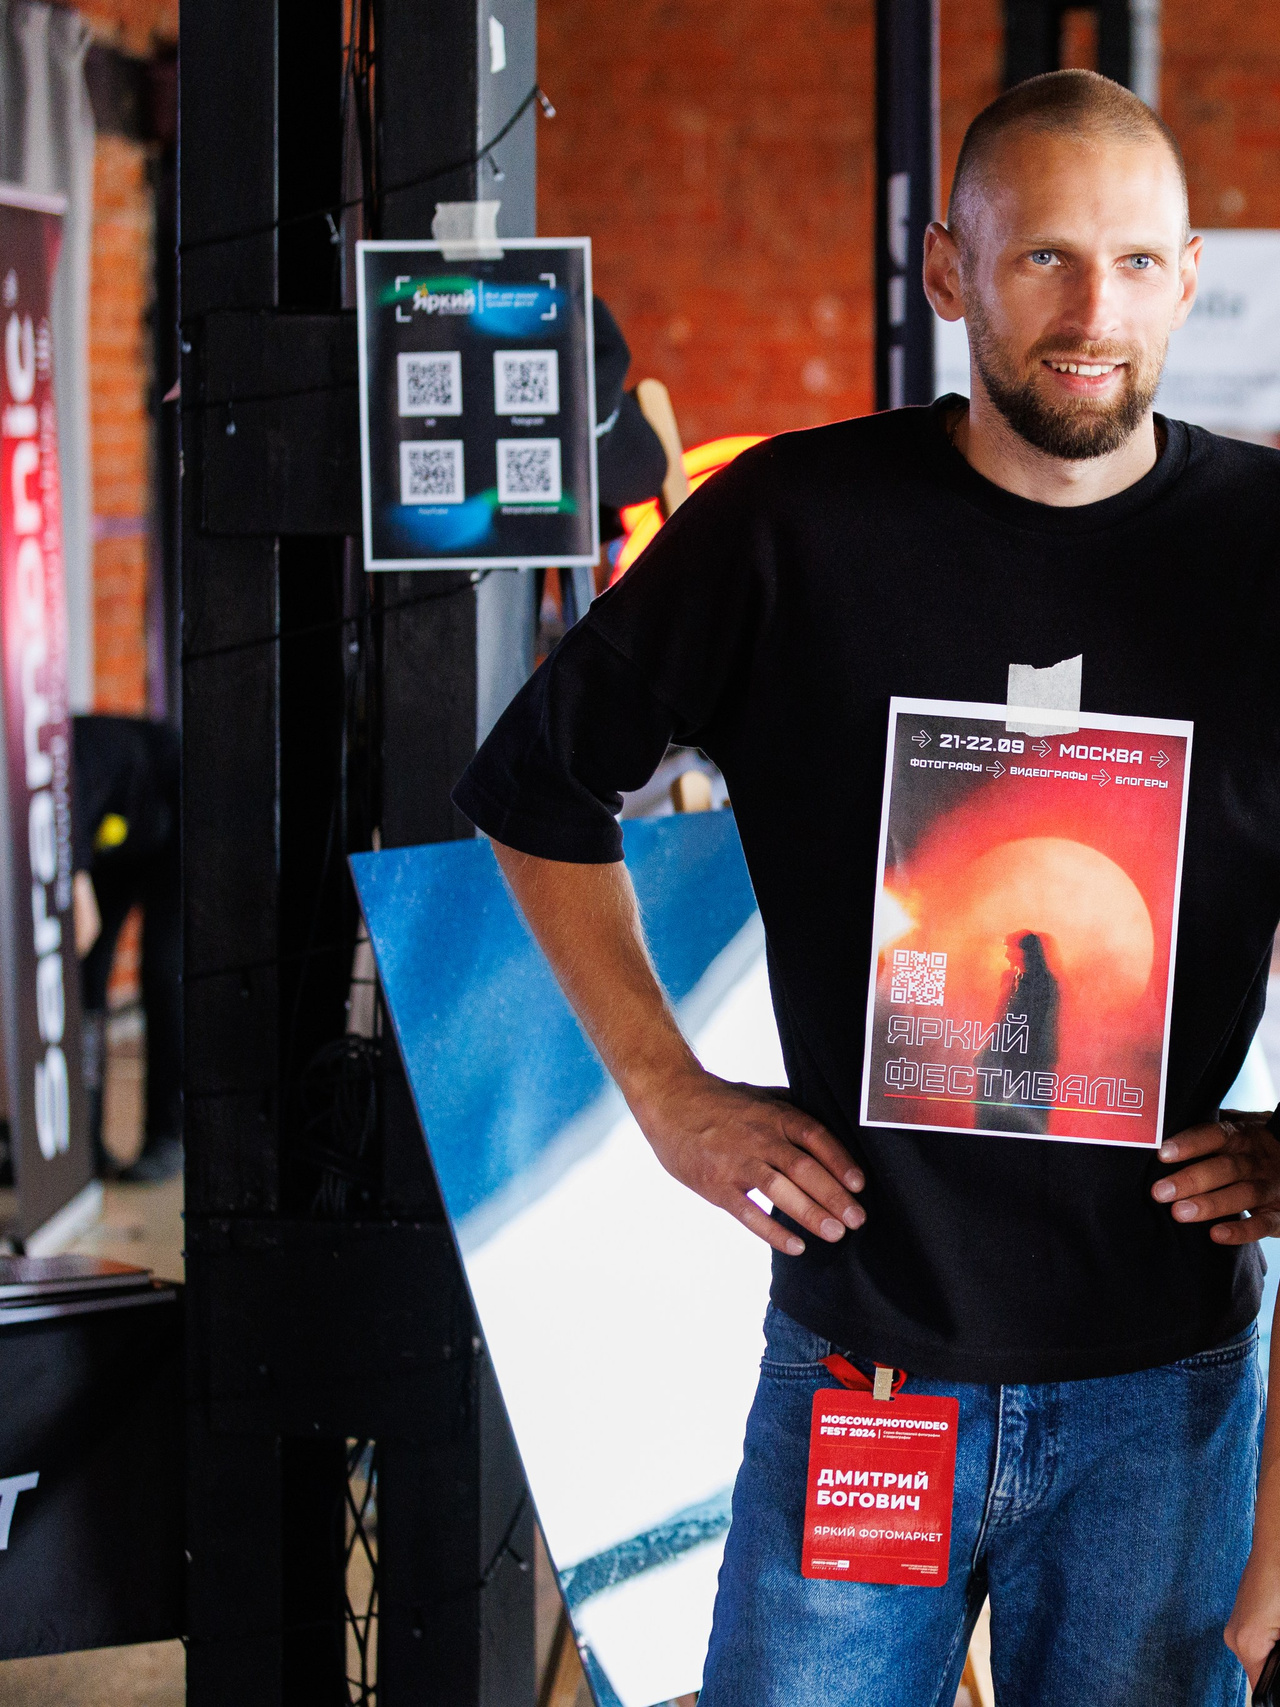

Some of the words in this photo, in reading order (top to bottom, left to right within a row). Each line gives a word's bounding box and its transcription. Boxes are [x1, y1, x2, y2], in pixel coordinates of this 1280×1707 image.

[939, 733, 1025, 754] 21-22.09
[1059, 743, 1143, 765] МОСКВА
[910, 758, 983, 773] ФОТОГРАФЫ
[1009, 766, 1088, 781] ВИДЕОГРАФЫ
[1115, 776, 1169, 789] БЛОГЕРЫ
[887, 1013, 1029, 1054] ЯРКИЙ
[884, 1057, 1145, 1109] ФЕСТИВАЛЬ
[820, 1414, 949, 1431] MOSCOW.PHOTOVIDEO
[820, 1427, 848, 1436] FEST
[849, 1428, 877, 1438] 2024
[816, 1469, 929, 1490] ДМИТРИЙ
[816, 1489, 921, 1511] БОГОВИЧ
[813, 1525, 856, 1537] ЯРКИЙ
[858, 1528, 943, 1543] ФОТОМАРКЕТ
